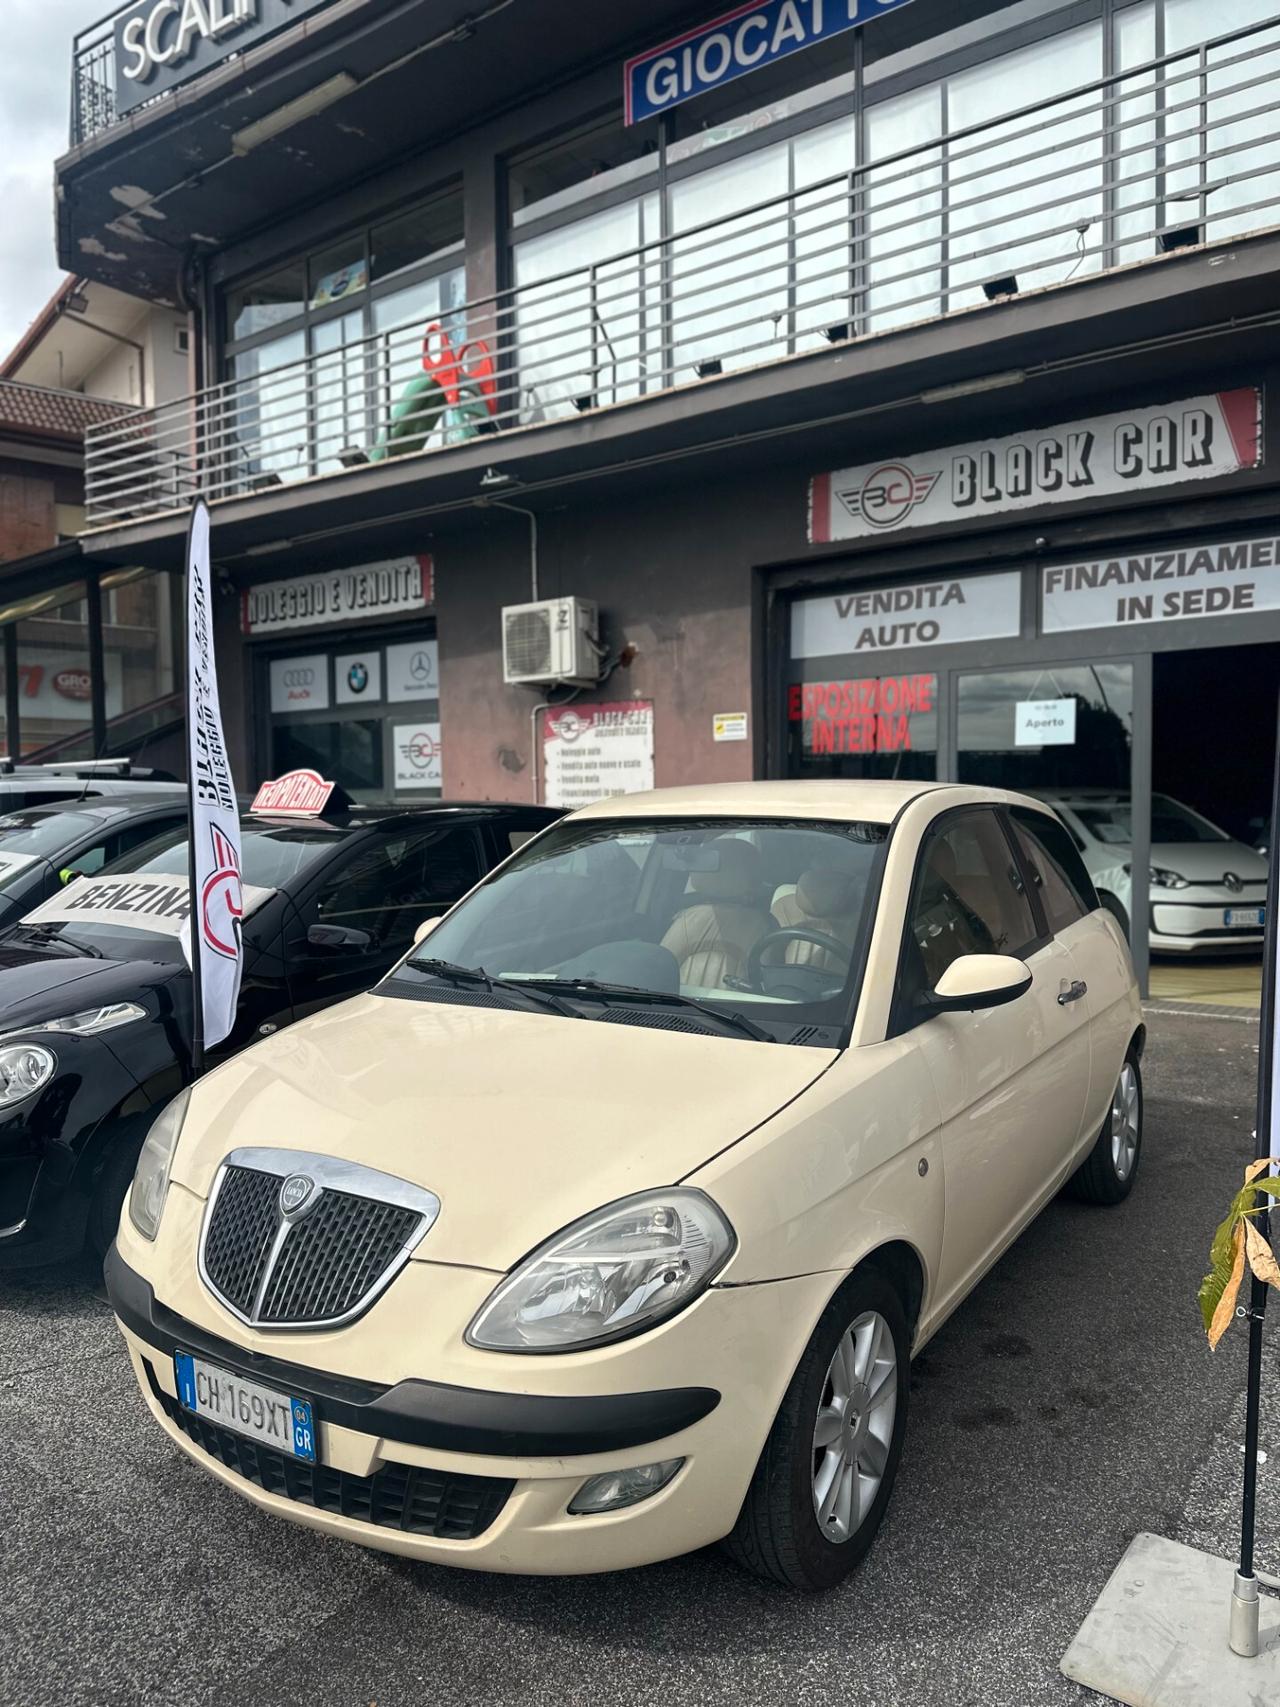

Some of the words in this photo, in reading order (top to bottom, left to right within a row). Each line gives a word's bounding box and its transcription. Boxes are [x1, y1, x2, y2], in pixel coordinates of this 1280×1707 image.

[952, 430, 1094, 508] BLACK
[1113, 409, 1214, 478] CAR
[1045, 539, 1280, 594] FINANZIAME
[330, 578, 340, 612] E
[345, 563, 424, 611] VENDITA
[833, 582, 966, 618] VENDITA
[1116, 595, 1154, 622] IN
[1162, 583, 1256, 617] SEDE
[855, 619, 941, 650] AUTO
[788, 672, 933, 721] ESPOSIZIONE
[811, 714, 912, 755] INTERNA
[1025, 718, 1065, 730] Aperto
[202, 706, 235, 812] NOLEGGIO
[64, 882, 191, 920] BENZINA
[295, 1426, 313, 1452] GR
